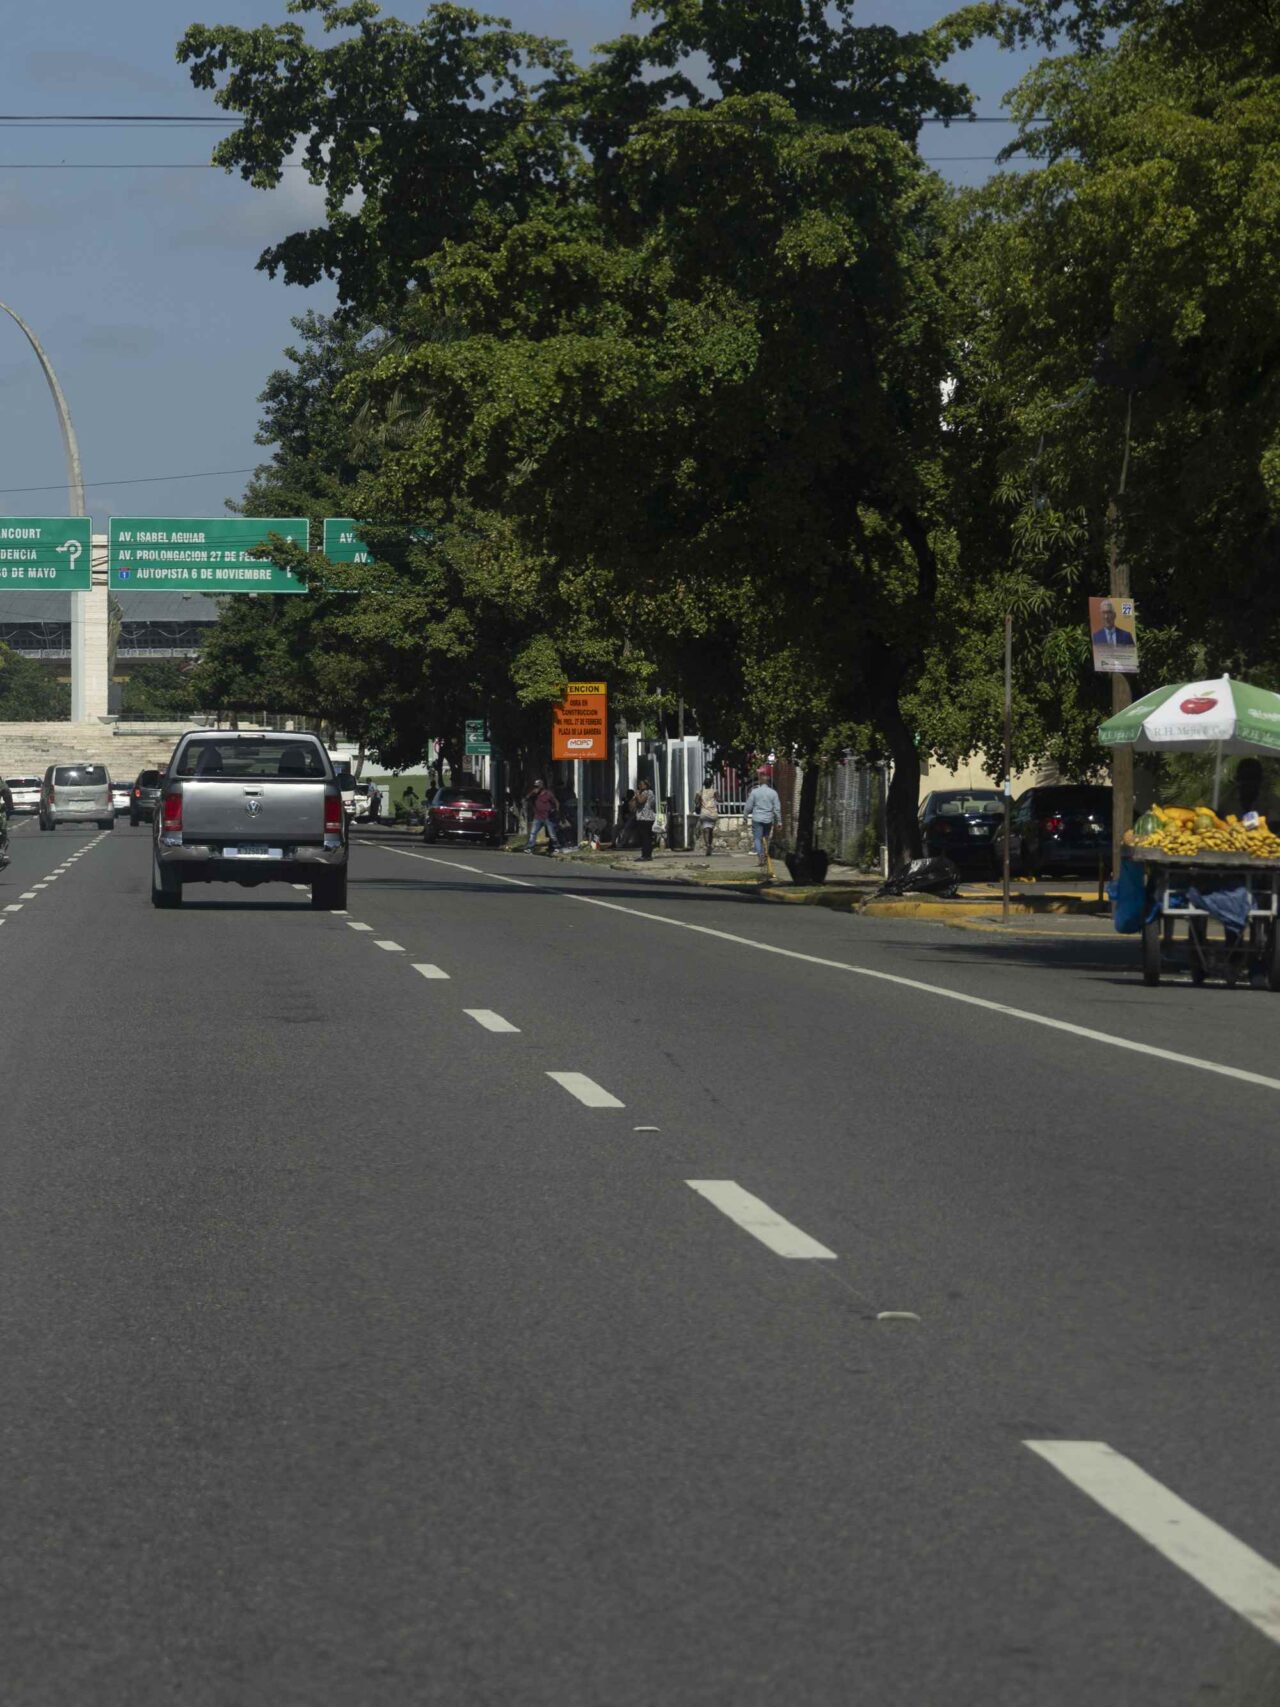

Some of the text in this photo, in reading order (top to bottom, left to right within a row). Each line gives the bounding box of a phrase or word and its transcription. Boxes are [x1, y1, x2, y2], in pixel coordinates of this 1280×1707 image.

[119, 532, 205, 543] AV. ISABEL AGUIAR
[340, 533, 356, 543] AV.
[119, 550, 133, 560] AV.
[136, 551, 207, 561] PROLONGACION
[210, 551, 221, 561] 27
[224, 551, 236, 561] DE
[353, 552, 371, 563] AV.
[11, 568, 24, 578] DE
[28, 568, 56, 578] MAYO
[136, 568, 272, 579] AUTOPISTA 6 DE NOVIEMBRE
[1123, 607, 1131, 615] 27
[567, 685, 600, 693] ENCION
